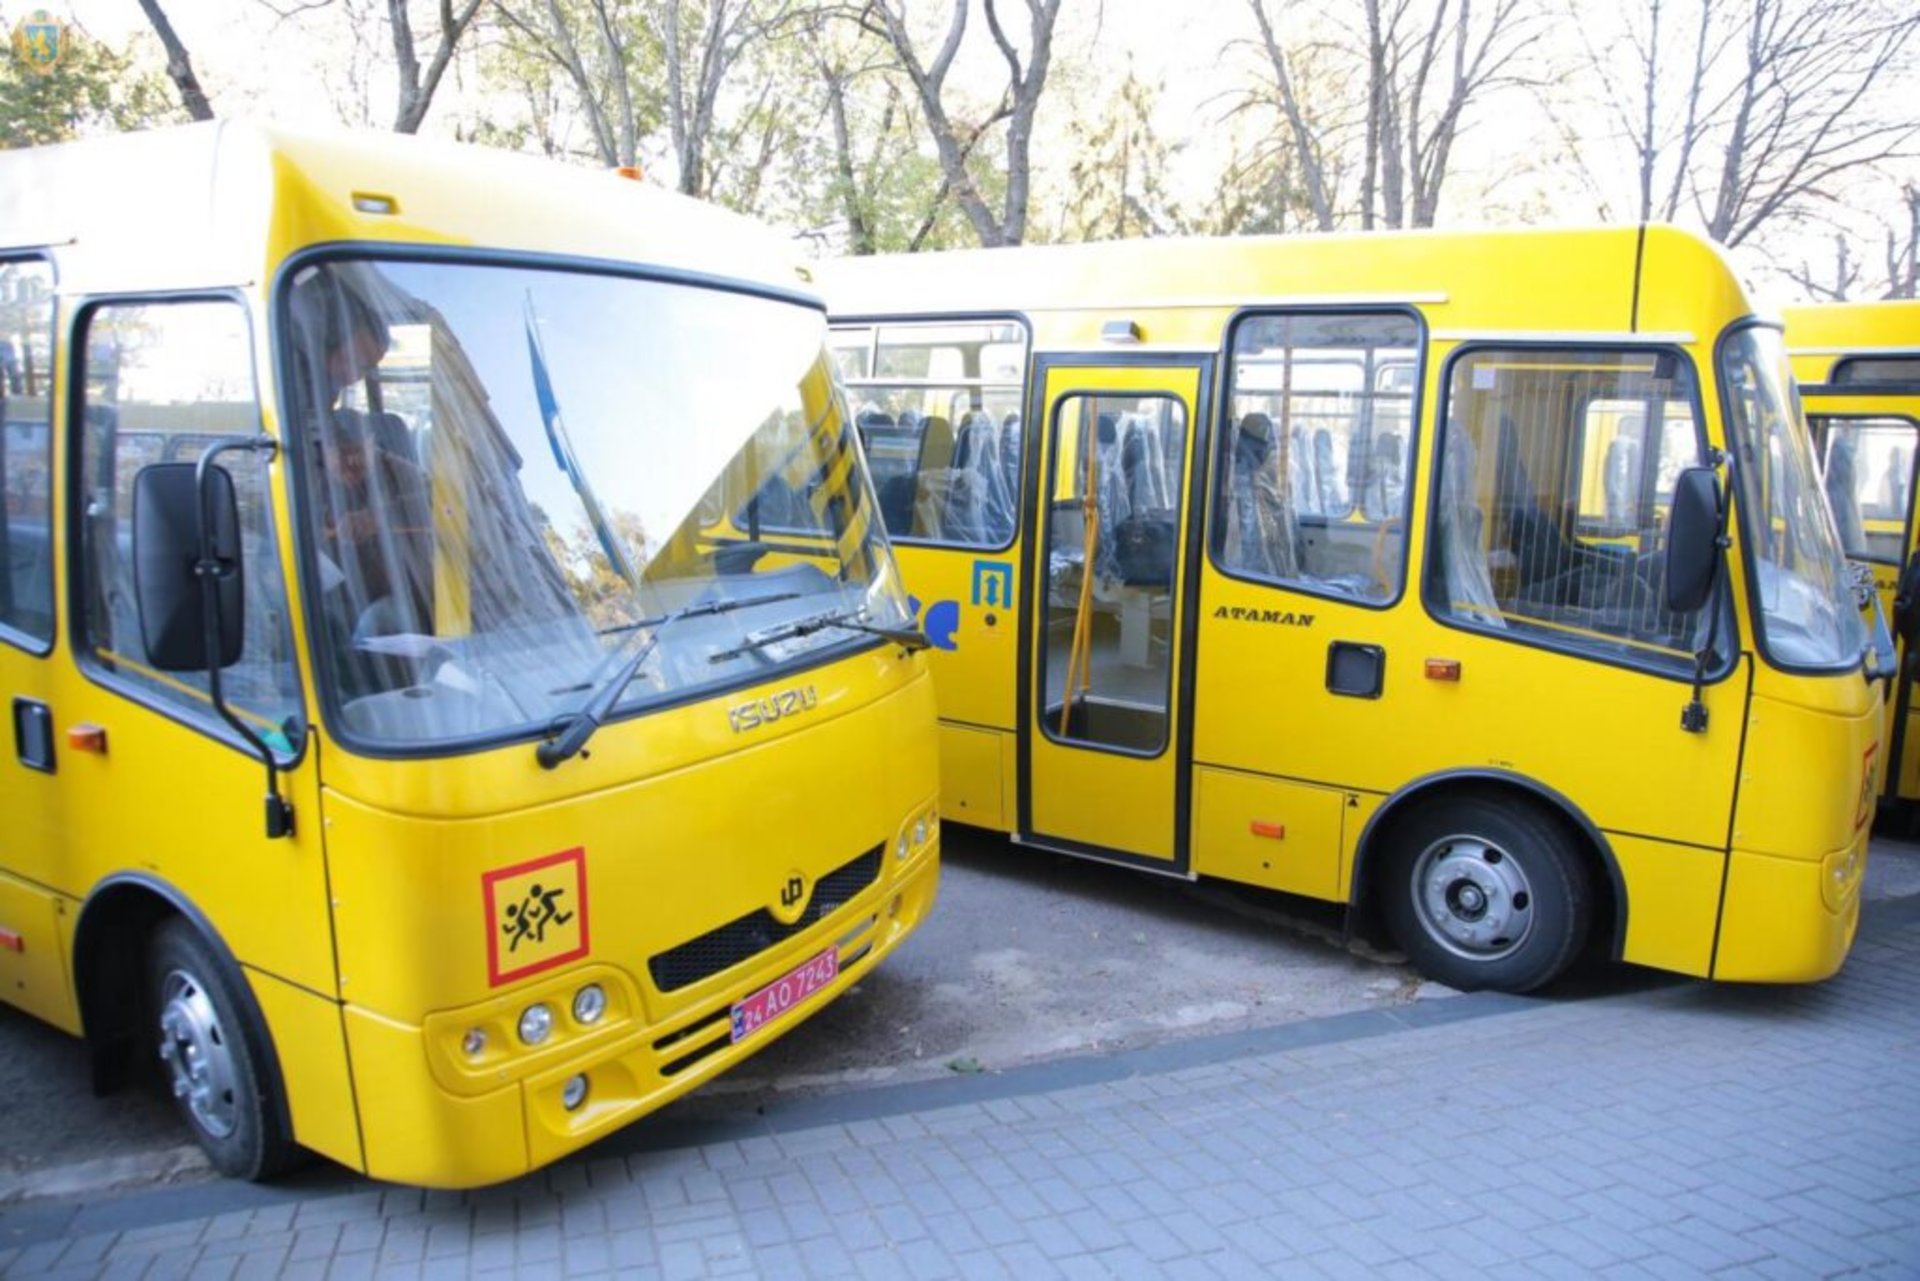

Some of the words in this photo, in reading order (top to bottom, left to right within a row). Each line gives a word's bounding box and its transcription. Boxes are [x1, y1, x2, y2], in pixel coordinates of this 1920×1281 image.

[1213, 605, 1316, 627] ATAMAN
[729, 684, 817, 733] ISUZU
[796, 953, 835, 998] 7243
